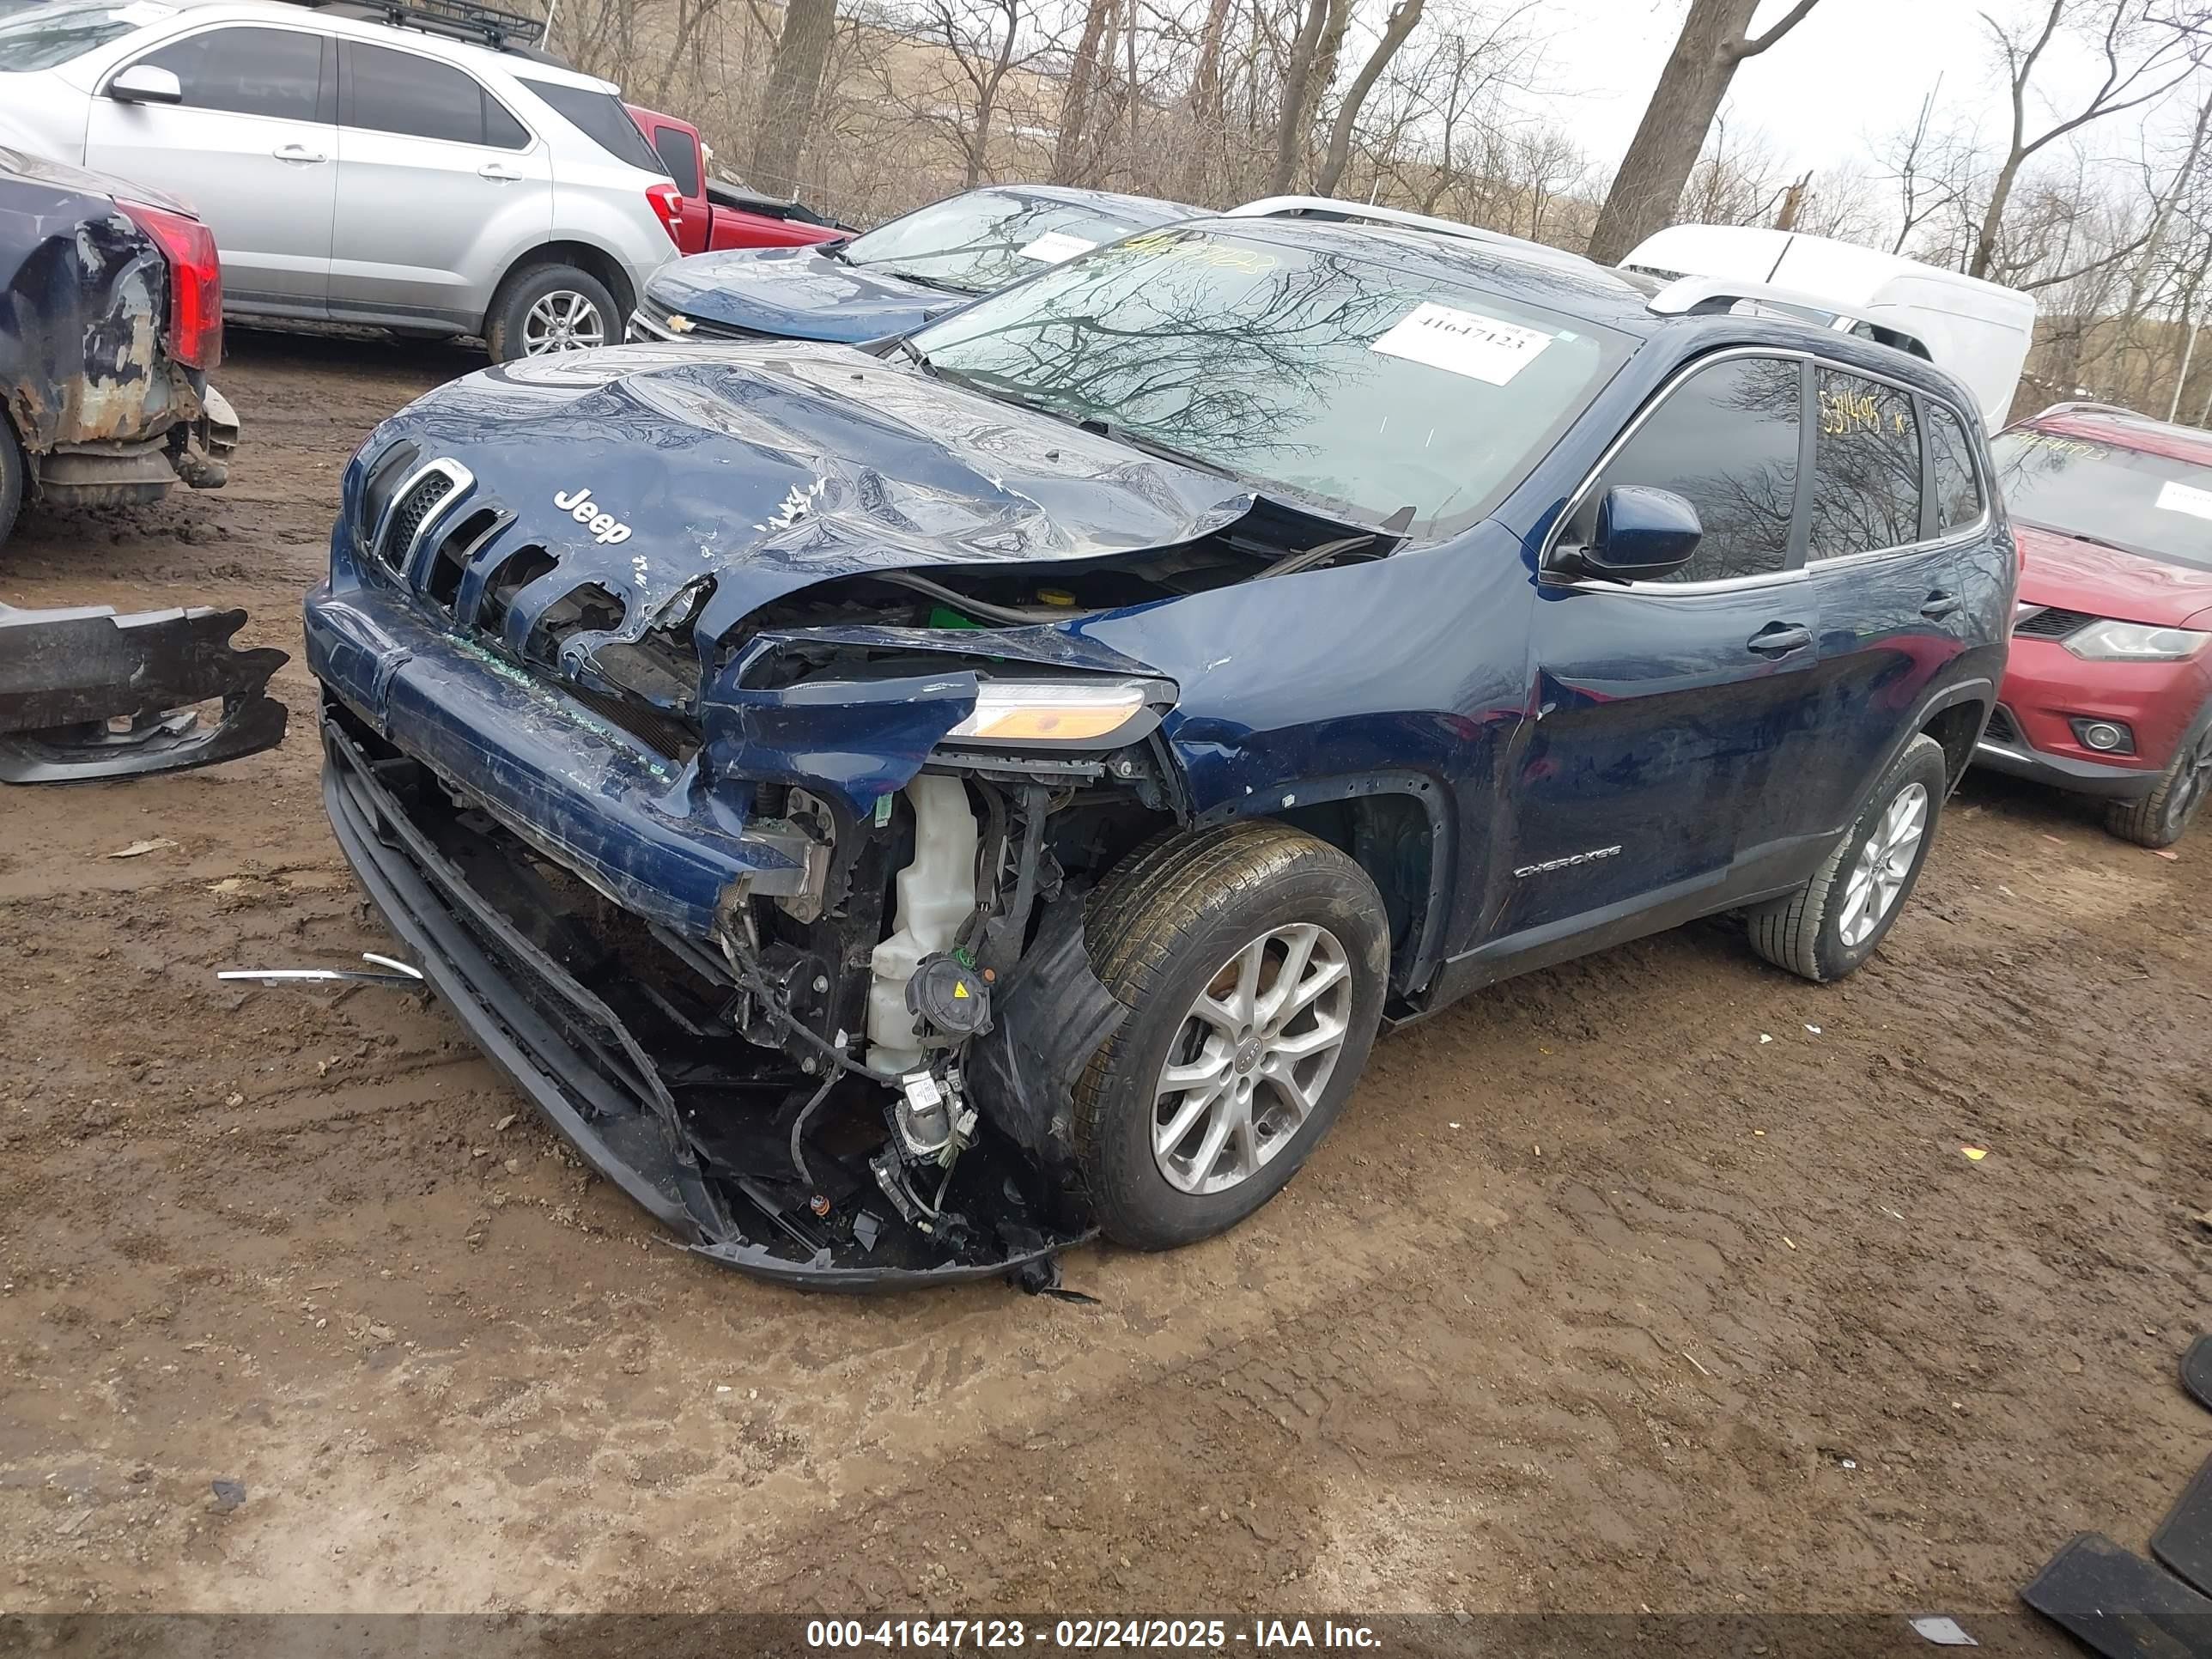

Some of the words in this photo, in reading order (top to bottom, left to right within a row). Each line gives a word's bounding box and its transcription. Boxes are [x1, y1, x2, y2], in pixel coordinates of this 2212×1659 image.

[1419, 317, 1525, 350] 41647123
[552, 487, 632, 545] Jeep
[1513, 845, 1622, 878] CHEROKEE
